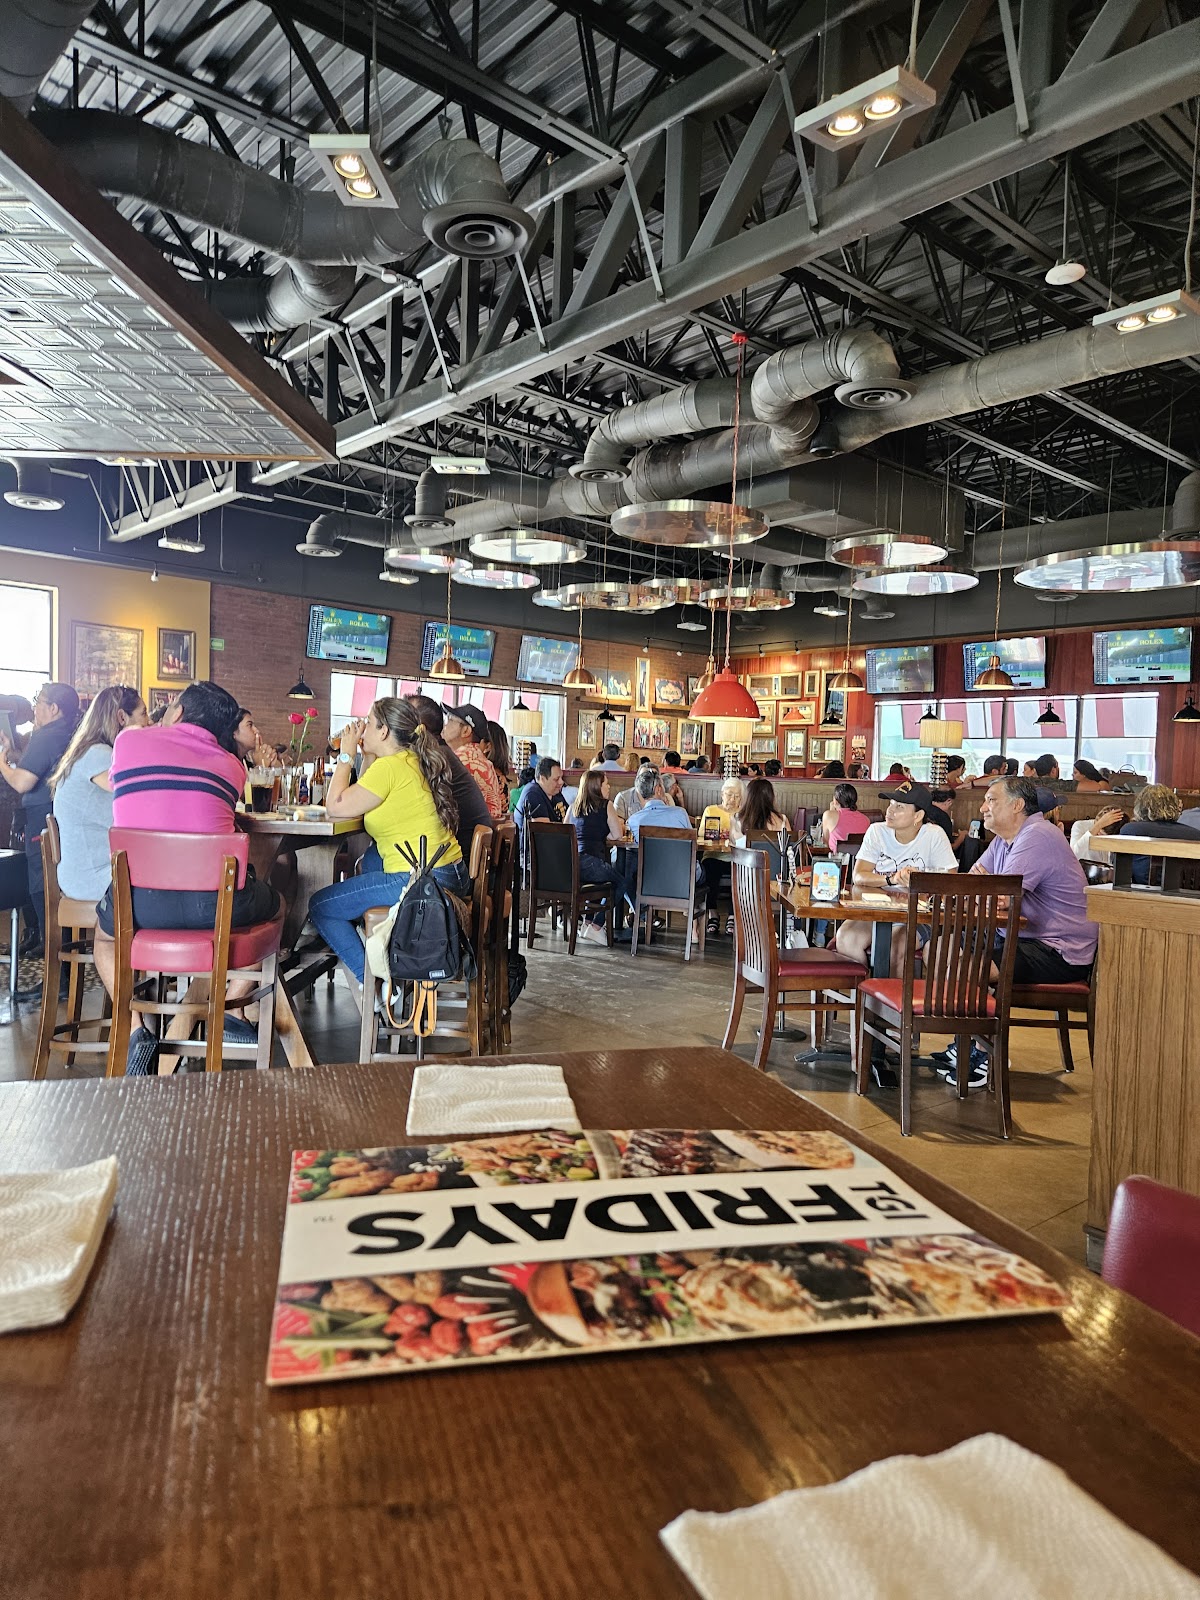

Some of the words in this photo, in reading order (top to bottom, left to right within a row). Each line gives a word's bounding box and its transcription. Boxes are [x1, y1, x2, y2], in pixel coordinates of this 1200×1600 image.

[459, 635, 477, 643] ROLEX
[347, 1182, 867, 1255] FRIDAYS
[849, 1181, 932, 1219] TGI
